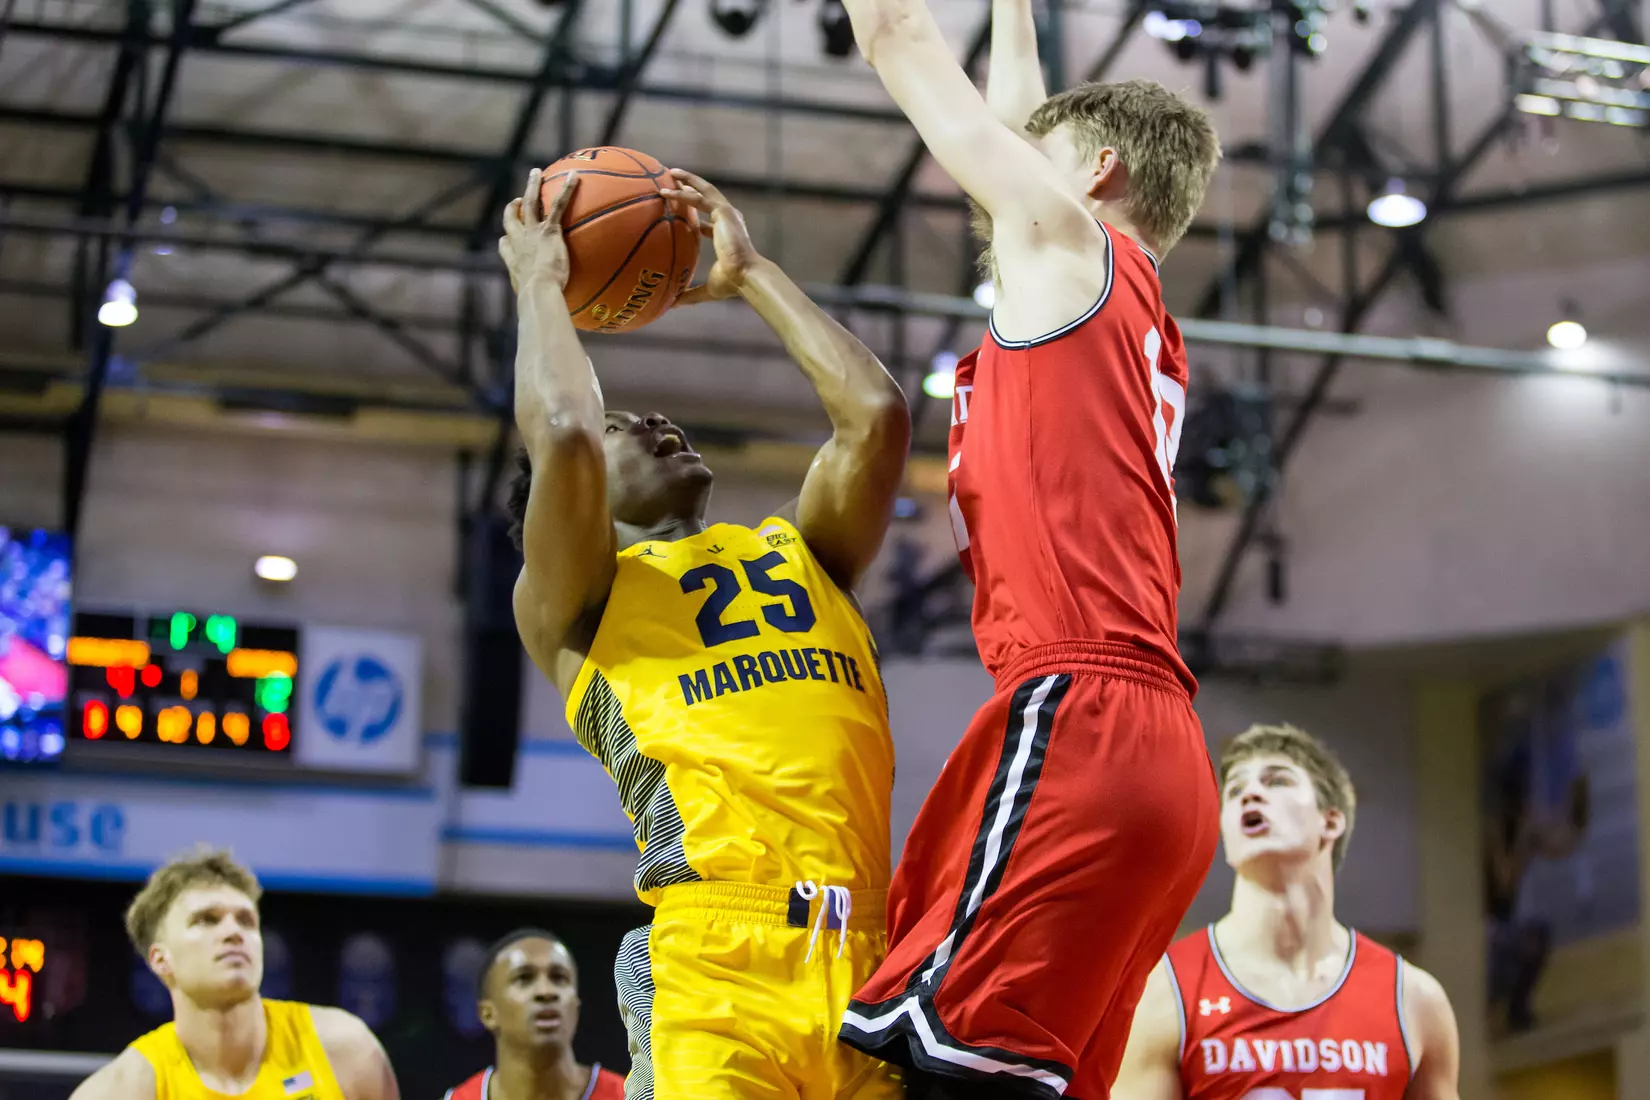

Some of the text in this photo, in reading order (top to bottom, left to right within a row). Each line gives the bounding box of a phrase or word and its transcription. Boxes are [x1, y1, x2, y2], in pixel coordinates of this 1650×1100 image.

[678, 551, 816, 648] 25
[678, 647, 865, 706] MARQUETTE
[1200, 1038, 1388, 1076] DAVIDSON
